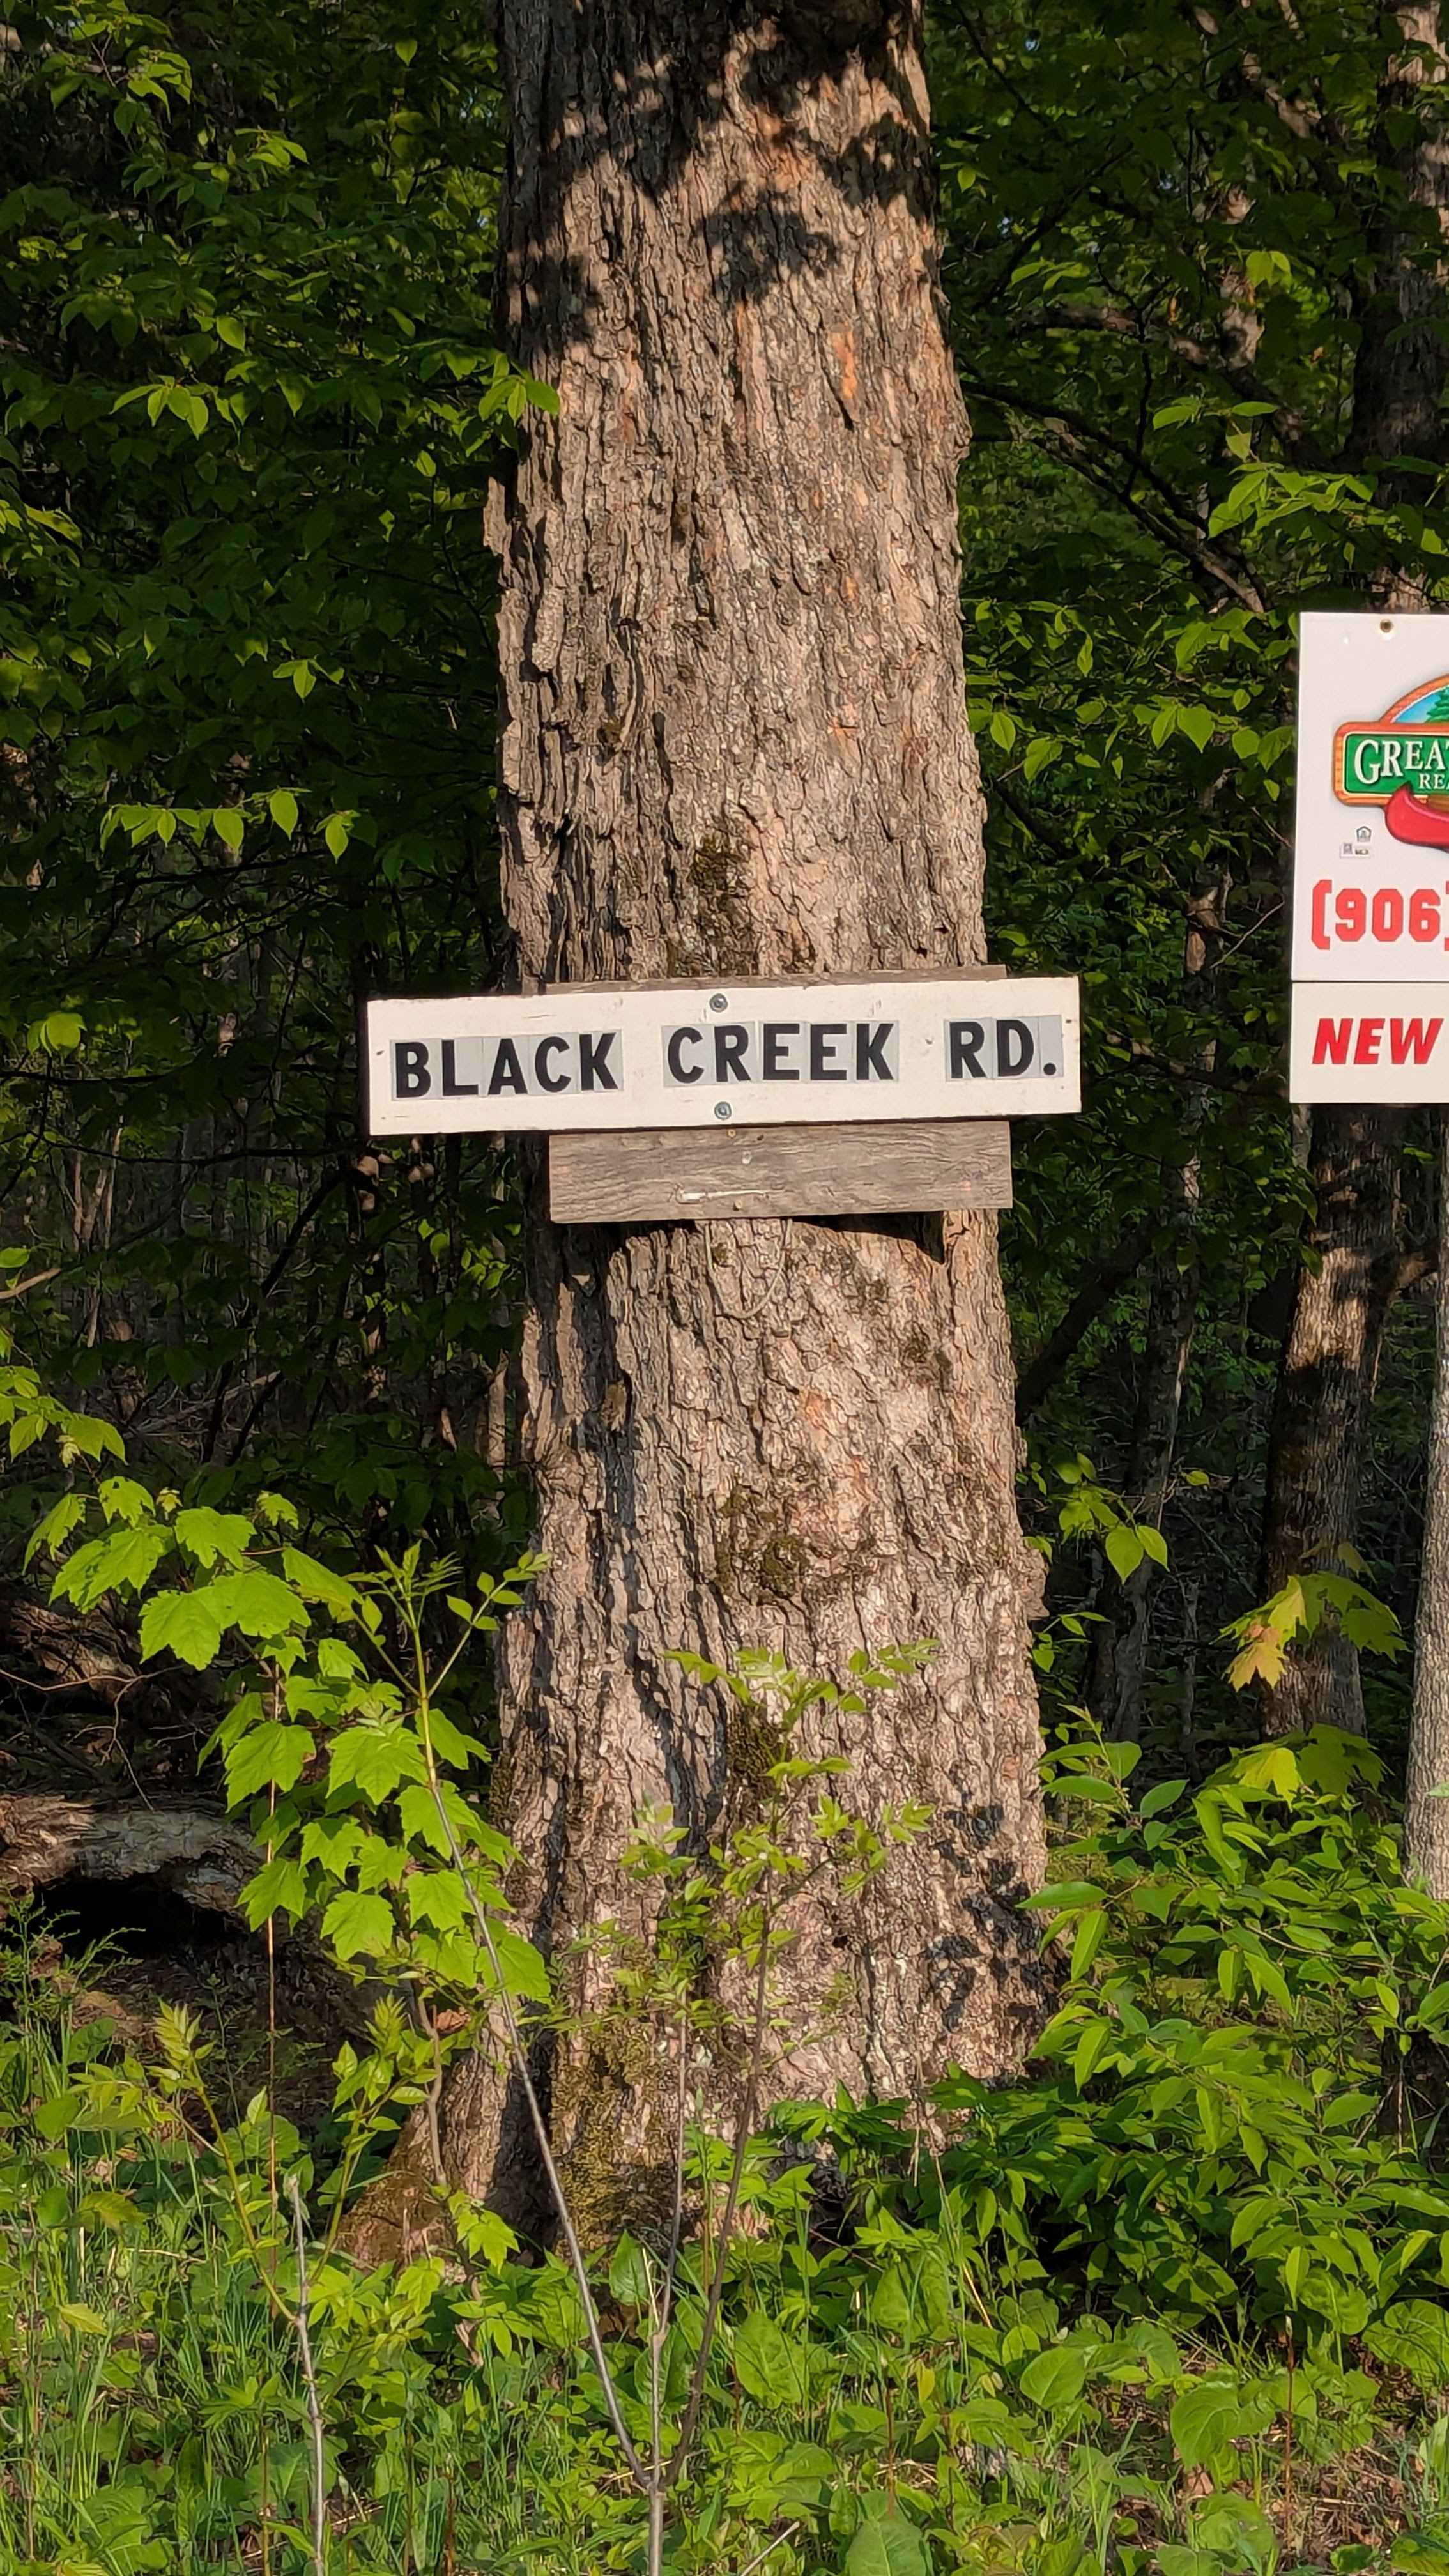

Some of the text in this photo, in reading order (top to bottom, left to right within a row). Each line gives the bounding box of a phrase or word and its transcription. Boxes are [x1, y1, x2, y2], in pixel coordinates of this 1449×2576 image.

[1354, 739, 1449, 785] GREA
[1418, 773, 1449, 790] RE
[1311, 879, 1449, 951] (906
[395, 1020, 1056, 1098] BLACK CREEK RD.
[1312, 1018, 1445, 1065] NEW
